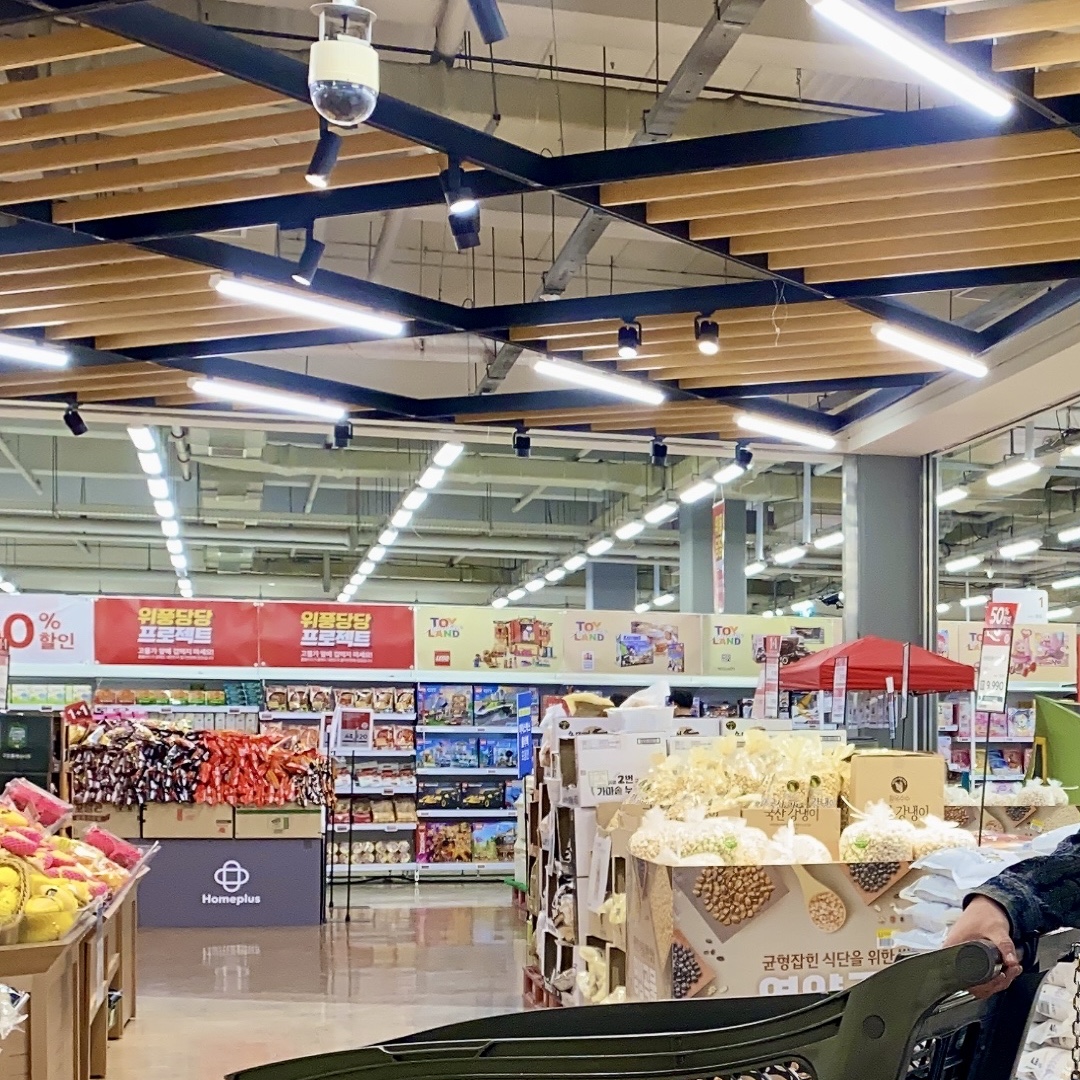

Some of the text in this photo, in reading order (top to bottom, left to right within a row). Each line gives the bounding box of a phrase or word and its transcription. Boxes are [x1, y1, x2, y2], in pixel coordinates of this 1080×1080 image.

[138, 607, 213, 626] 위풍당당
[300, 611, 372, 630] 위풍당당
[430, 617, 457, 628] TOY
[428, 629, 460, 638] LAND
[575, 621, 602, 632] TOY
[714, 625, 738, 636] TOY
[40, 632, 75, 650] 할인
[137, 626, 213, 645] 프로젝트
[300, 629, 371, 647] 프로젝트
[574, 633, 605, 641] LAND
[712, 637, 741, 645] LAND
[67, 704, 89, 720] 1+1
[202, 893, 261, 906] Homeplus
[762, 949, 895, 971] 균형잡힌 식단을 위한
